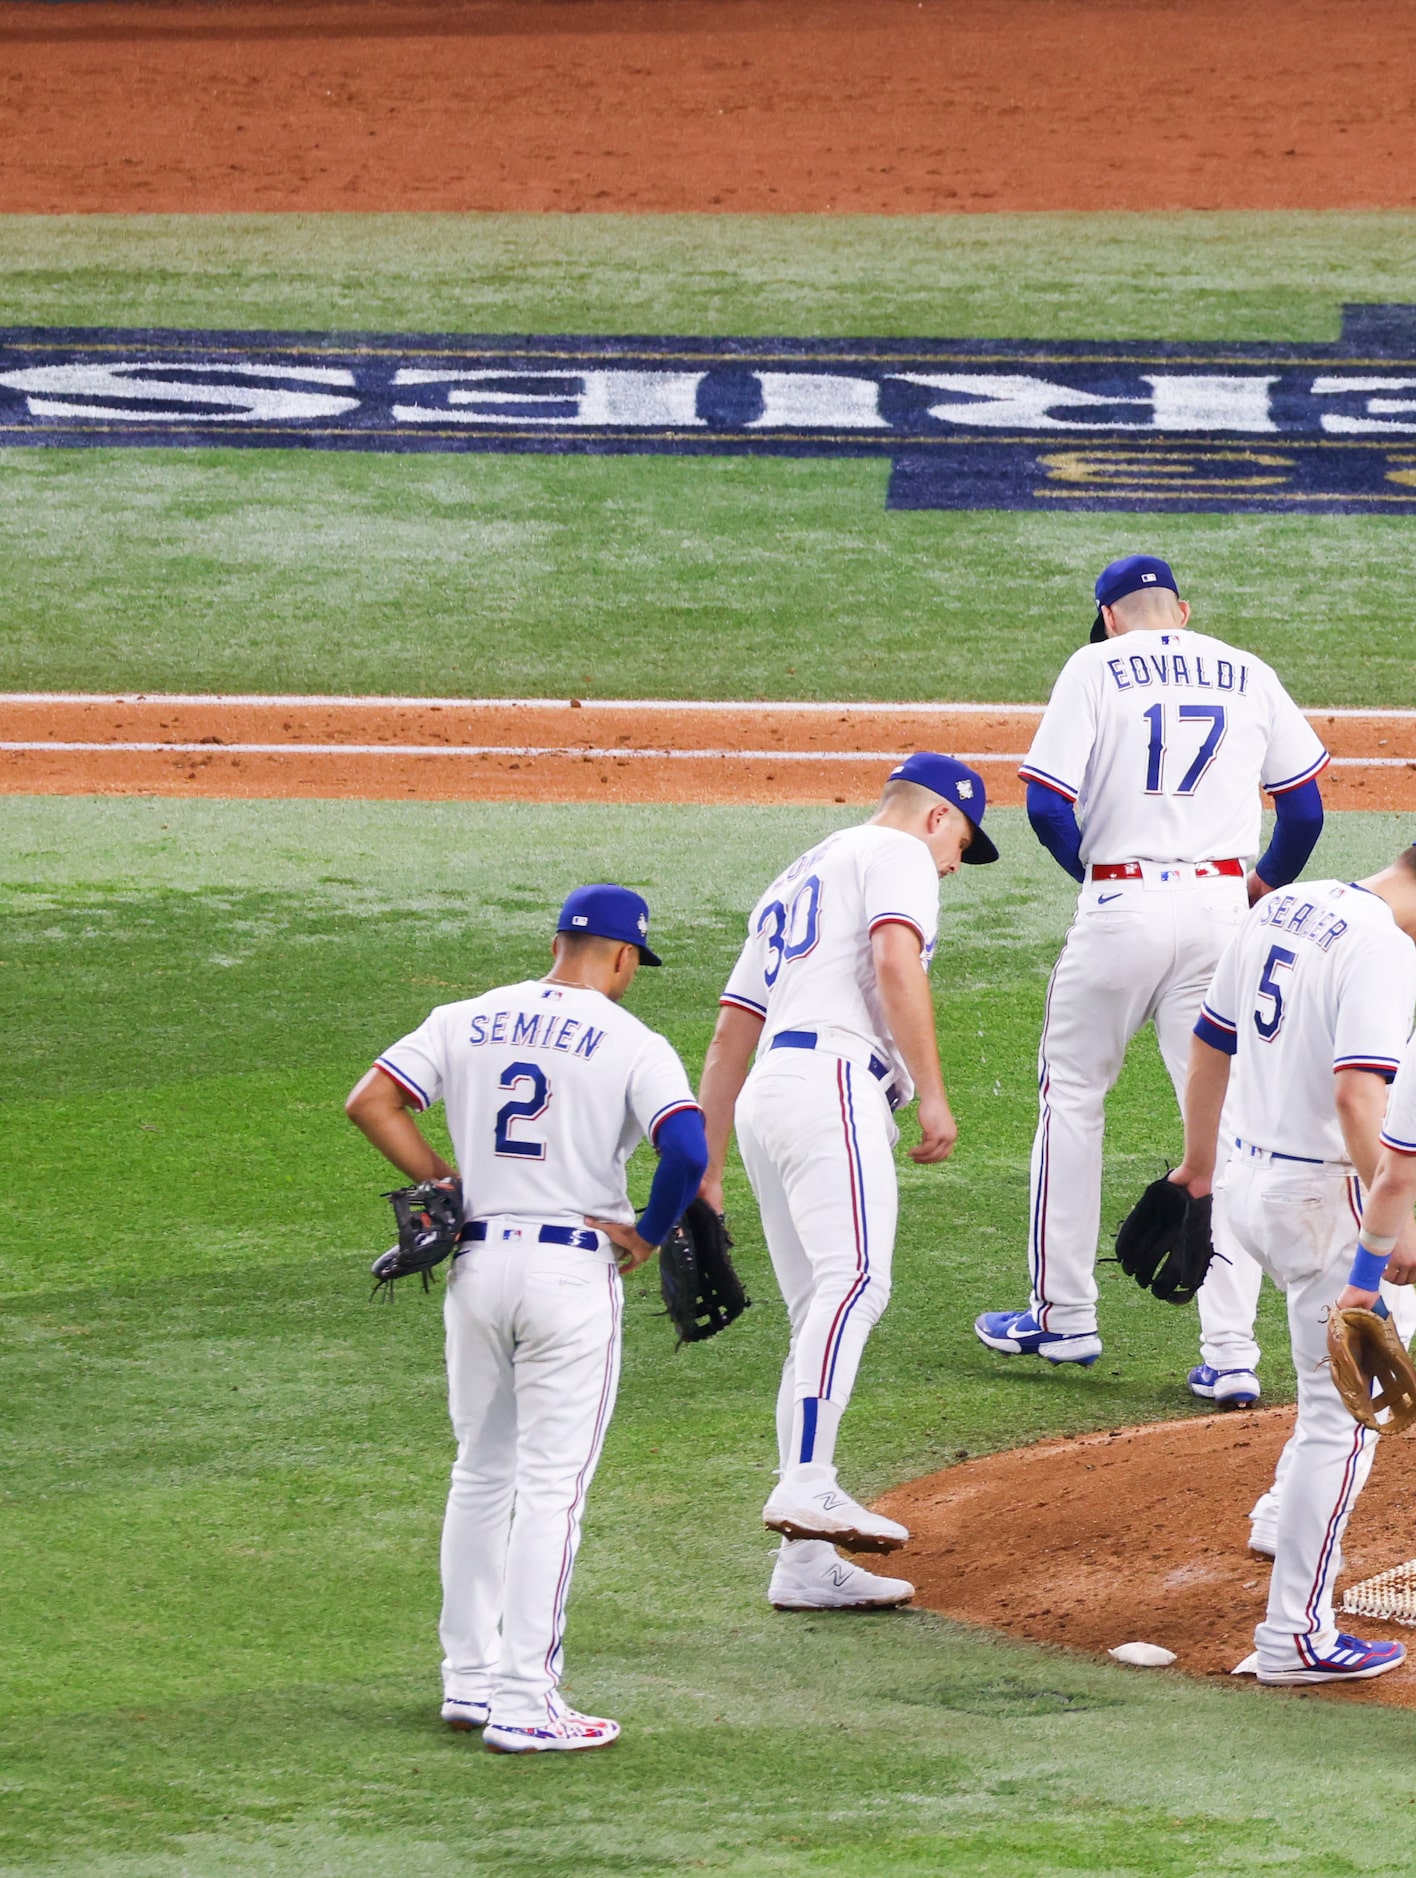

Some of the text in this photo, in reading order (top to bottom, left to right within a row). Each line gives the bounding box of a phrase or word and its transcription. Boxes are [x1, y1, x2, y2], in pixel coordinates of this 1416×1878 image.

[1107, 655, 1249, 696] EOVALDI
[1143, 703, 1228, 796] 17
[757, 874, 823, 992] 30
[470, 1011, 607, 1061] SEMIEN
[1254, 944, 1297, 1043] 5
[494, 1061, 553, 1161] 2
